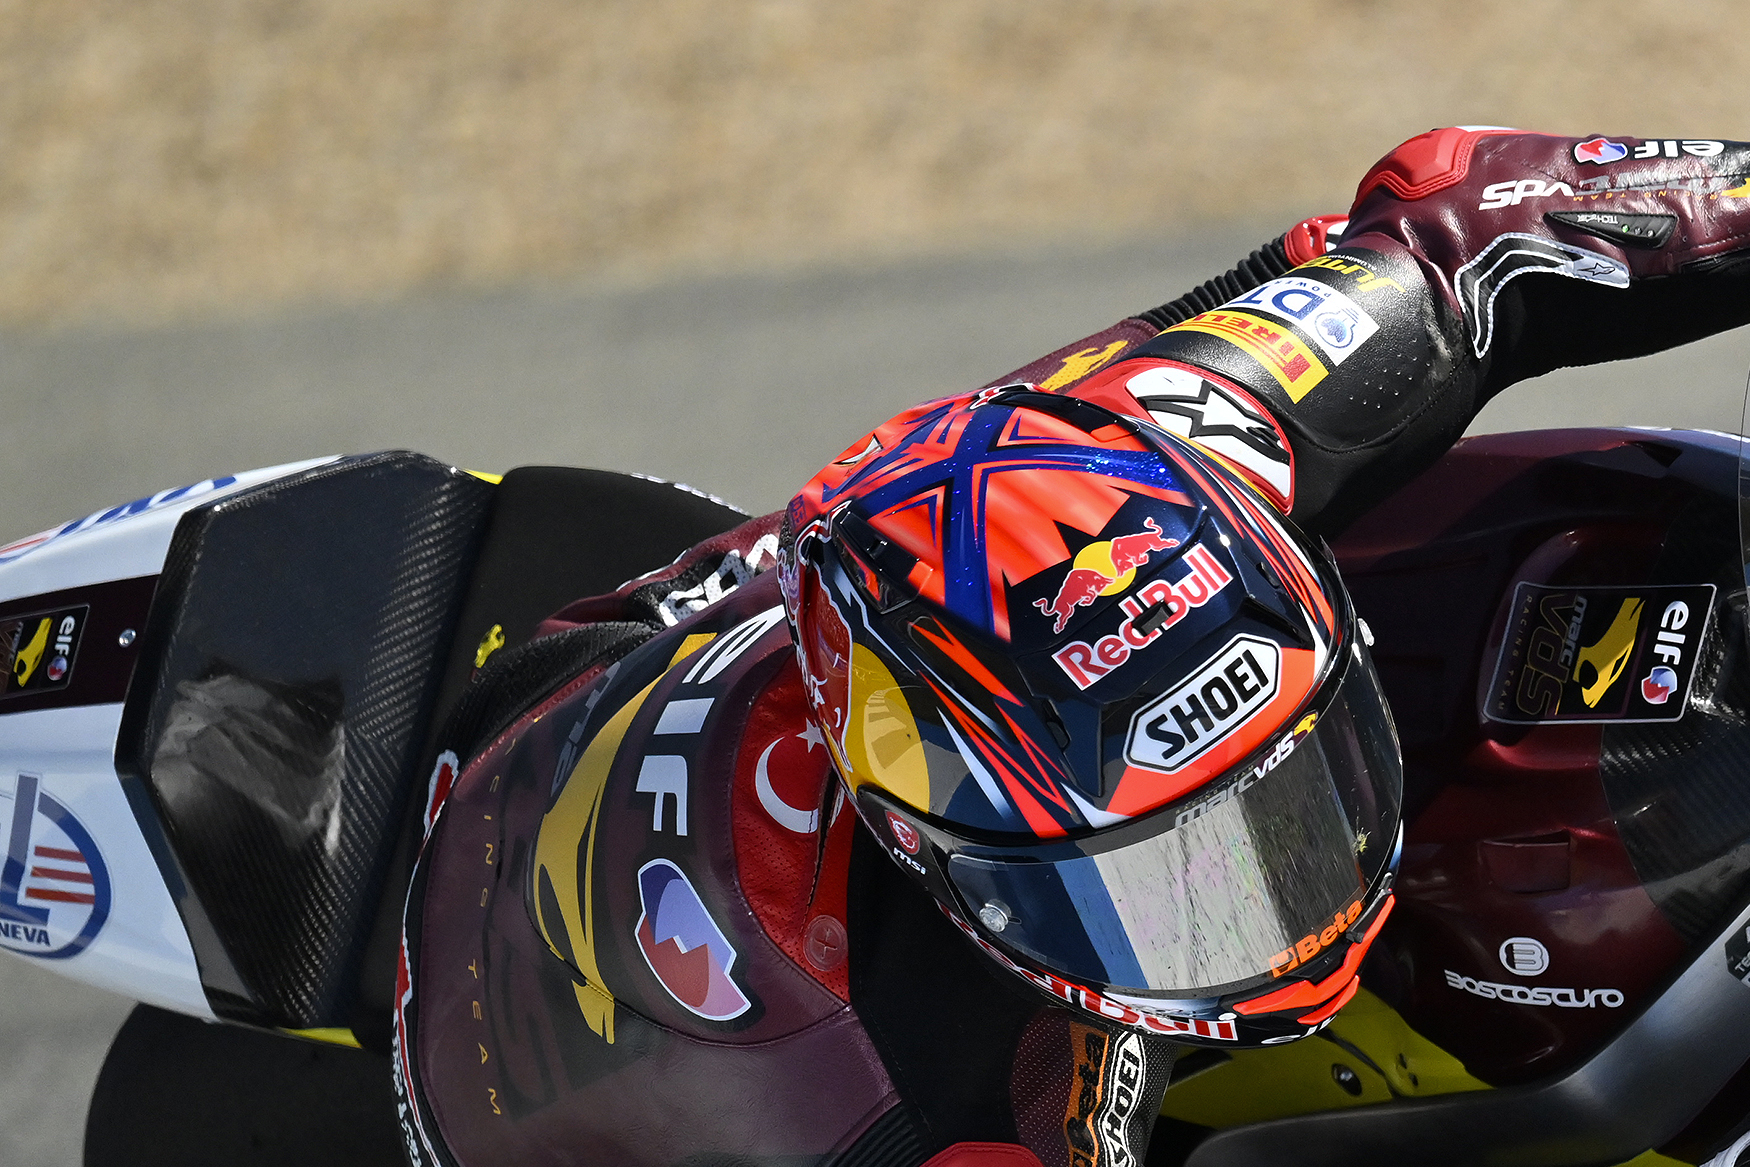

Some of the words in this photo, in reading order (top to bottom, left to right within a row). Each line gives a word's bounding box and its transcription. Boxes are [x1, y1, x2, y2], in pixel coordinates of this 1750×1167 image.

[1634, 140, 1725, 158] elf
[53, 615, 76, 657] elf
[1511, 594, 1532, 657] RACING
[1561, 595, 1588, 666] marc
[1654, 600, 1689, 665] elf
[1145, 649, 1269, 760] SHOEI
[1297, 899, 1364, 965] Beta
